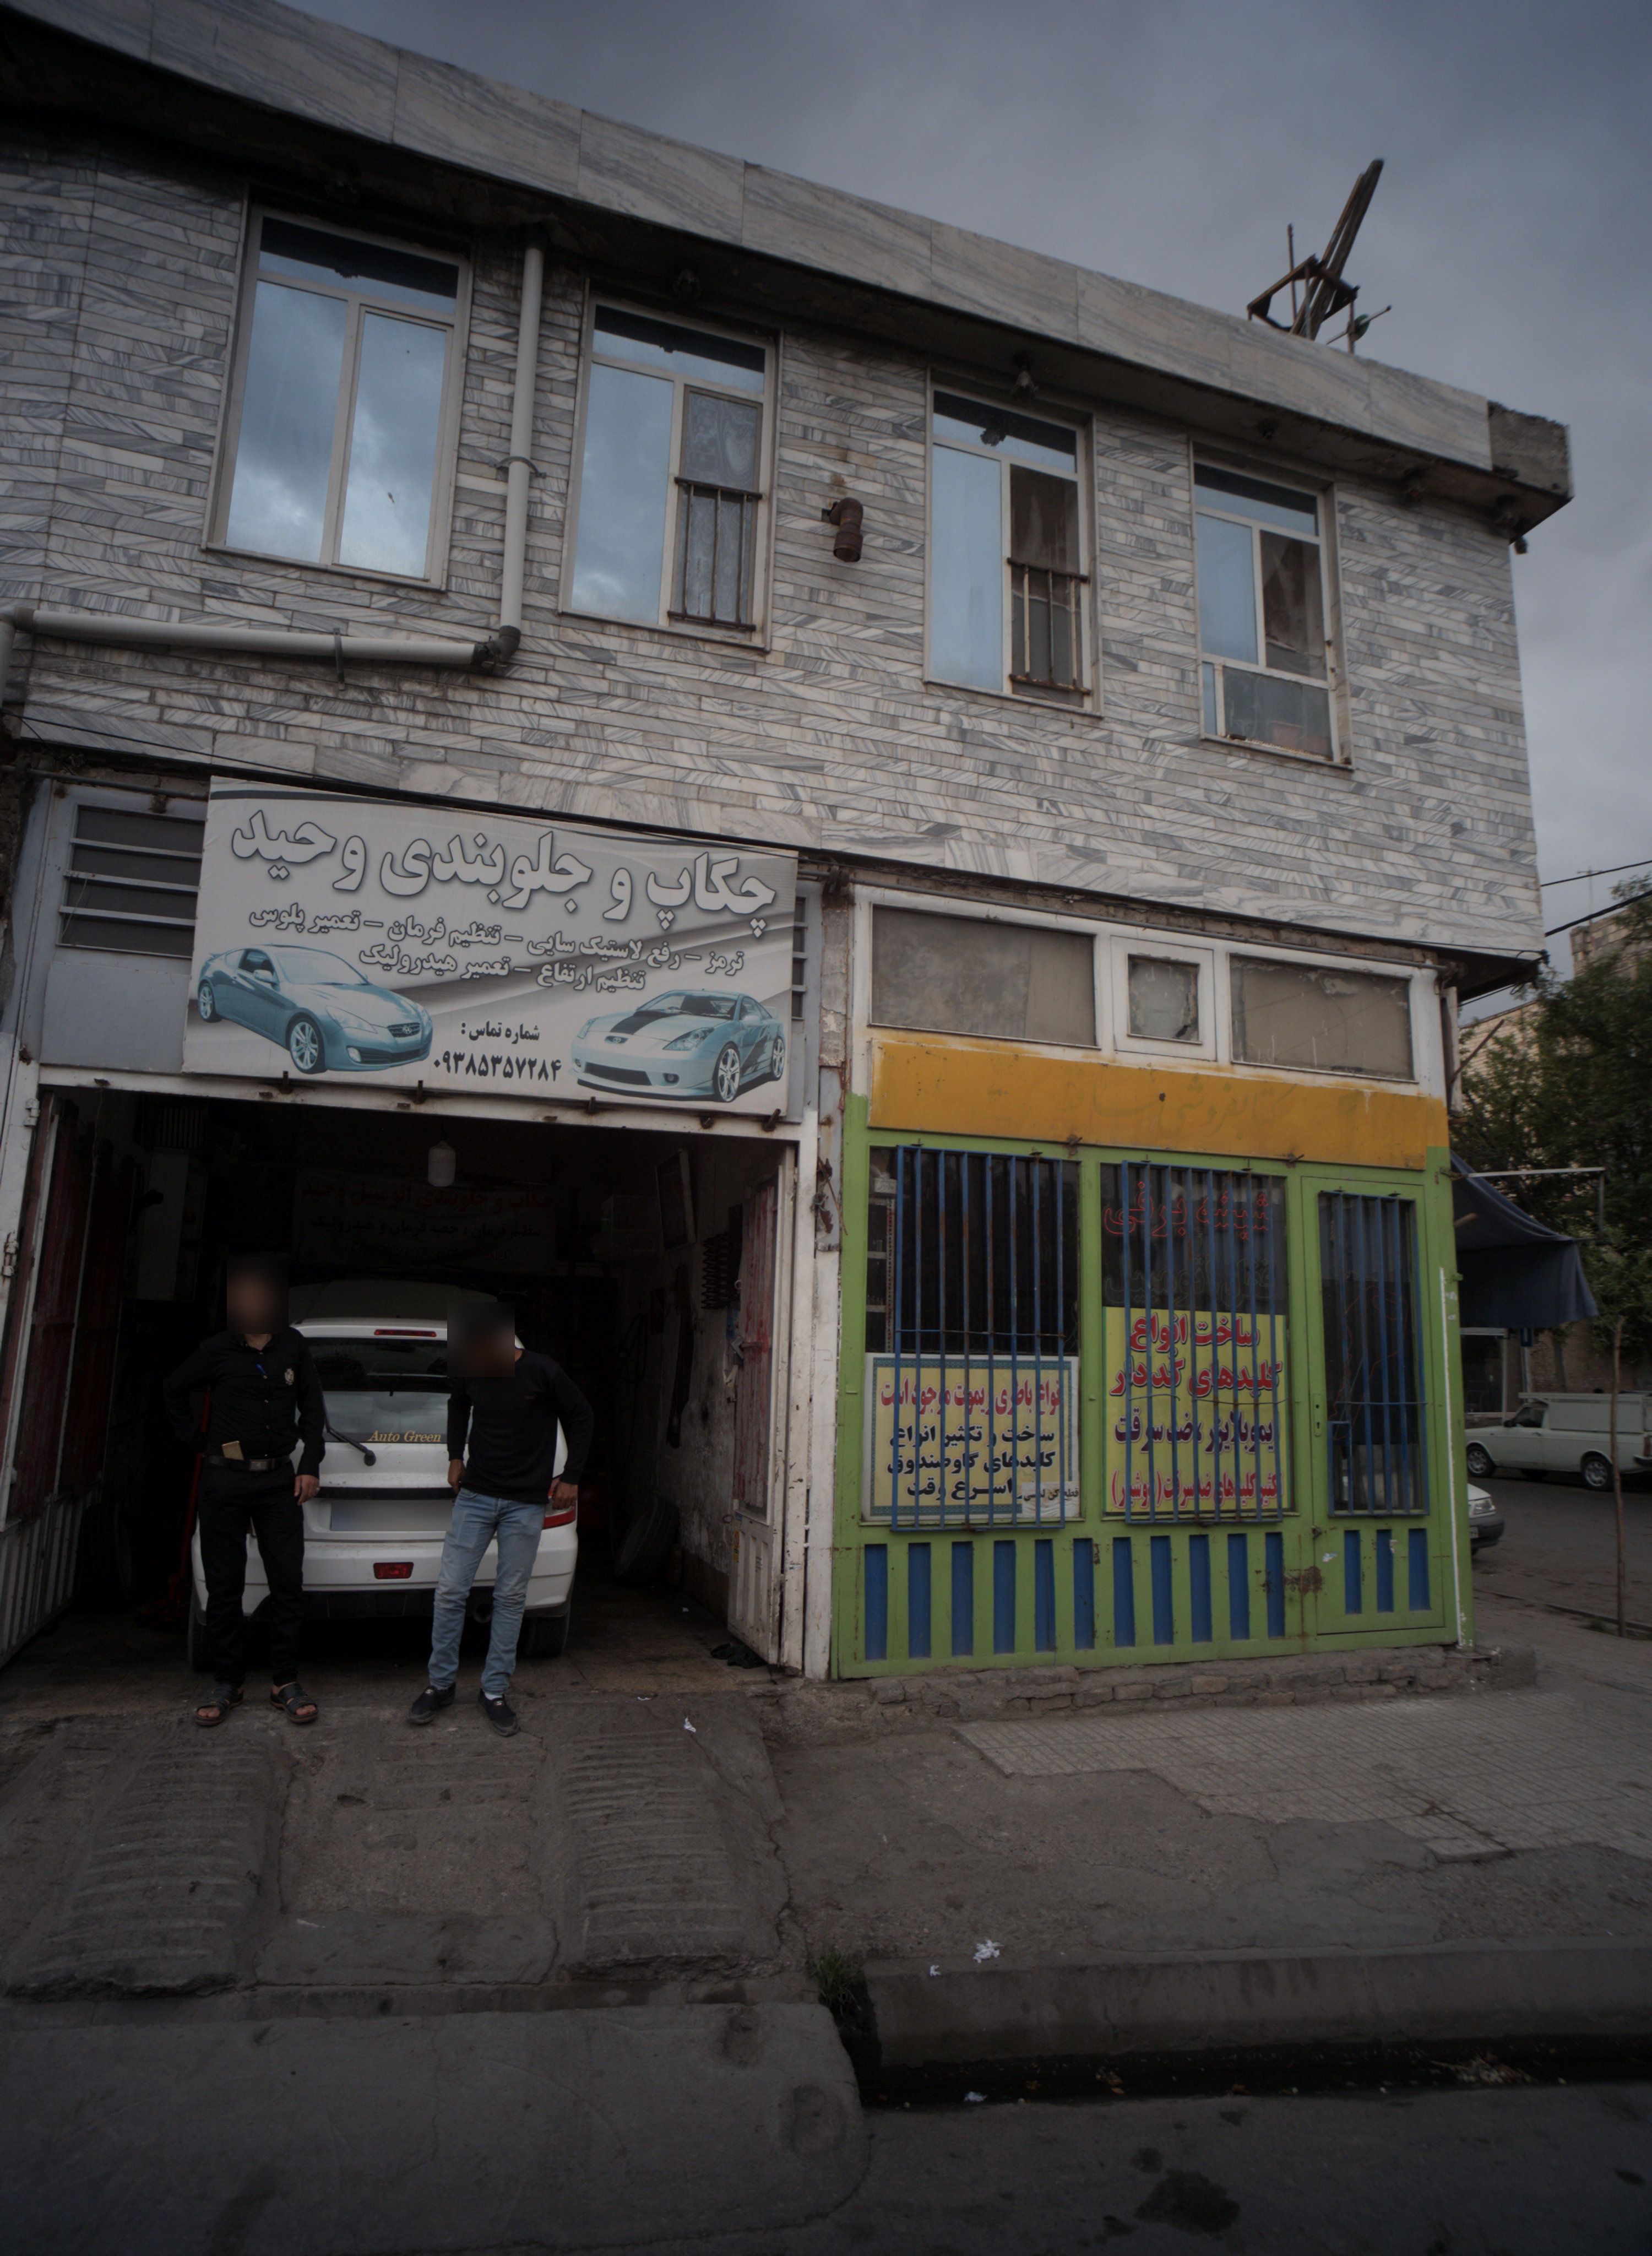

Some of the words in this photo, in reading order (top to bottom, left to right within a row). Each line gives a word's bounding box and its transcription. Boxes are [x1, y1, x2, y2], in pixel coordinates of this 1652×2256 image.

[231, 810, 366, 891] وحید
[380, 830, 593, 913] جلوبندی
[602, 867, 632, 920] و
[646, 852, 776, 938] چکاپ
[249, 903, 306, 932] پلوس
[307, 910, 361, 934] تعمیر
[388, 915, 446, 945] فرمان
[449, 921, 502, 947] تنظیم
[358, 945, 458, 977] هیدرولیک
[579, 936, 643, 961] لاستیک
[646, 941, 681, 969] رفع
[460, 956, 510, 980] تعمیر
[536, 962, 594, 990] ارتفاع
[705, 950, 745, 976] ترمز
[596, 967, 646, 993] تنظیم
[505, 1023, 540, 1044] شماره
[433, 1050, 562, 1082] ۰۹۳۸۵۳۵۷۲۸۴
[1129, 1313, 1188, 1353] انواع
[1192, 1315, 1260, 1346] ساخت
[1187, 1359, 1283, 1398] کلیدهای
[1037, 1379, 1063, 1416] نواع
[367, 1430, 400, 1442] Auto
[404, 1430, 441, 1442] Green
[889, 1424, 936, 1447] انواع
[1002, 1425, 1054, 1442] سخت
